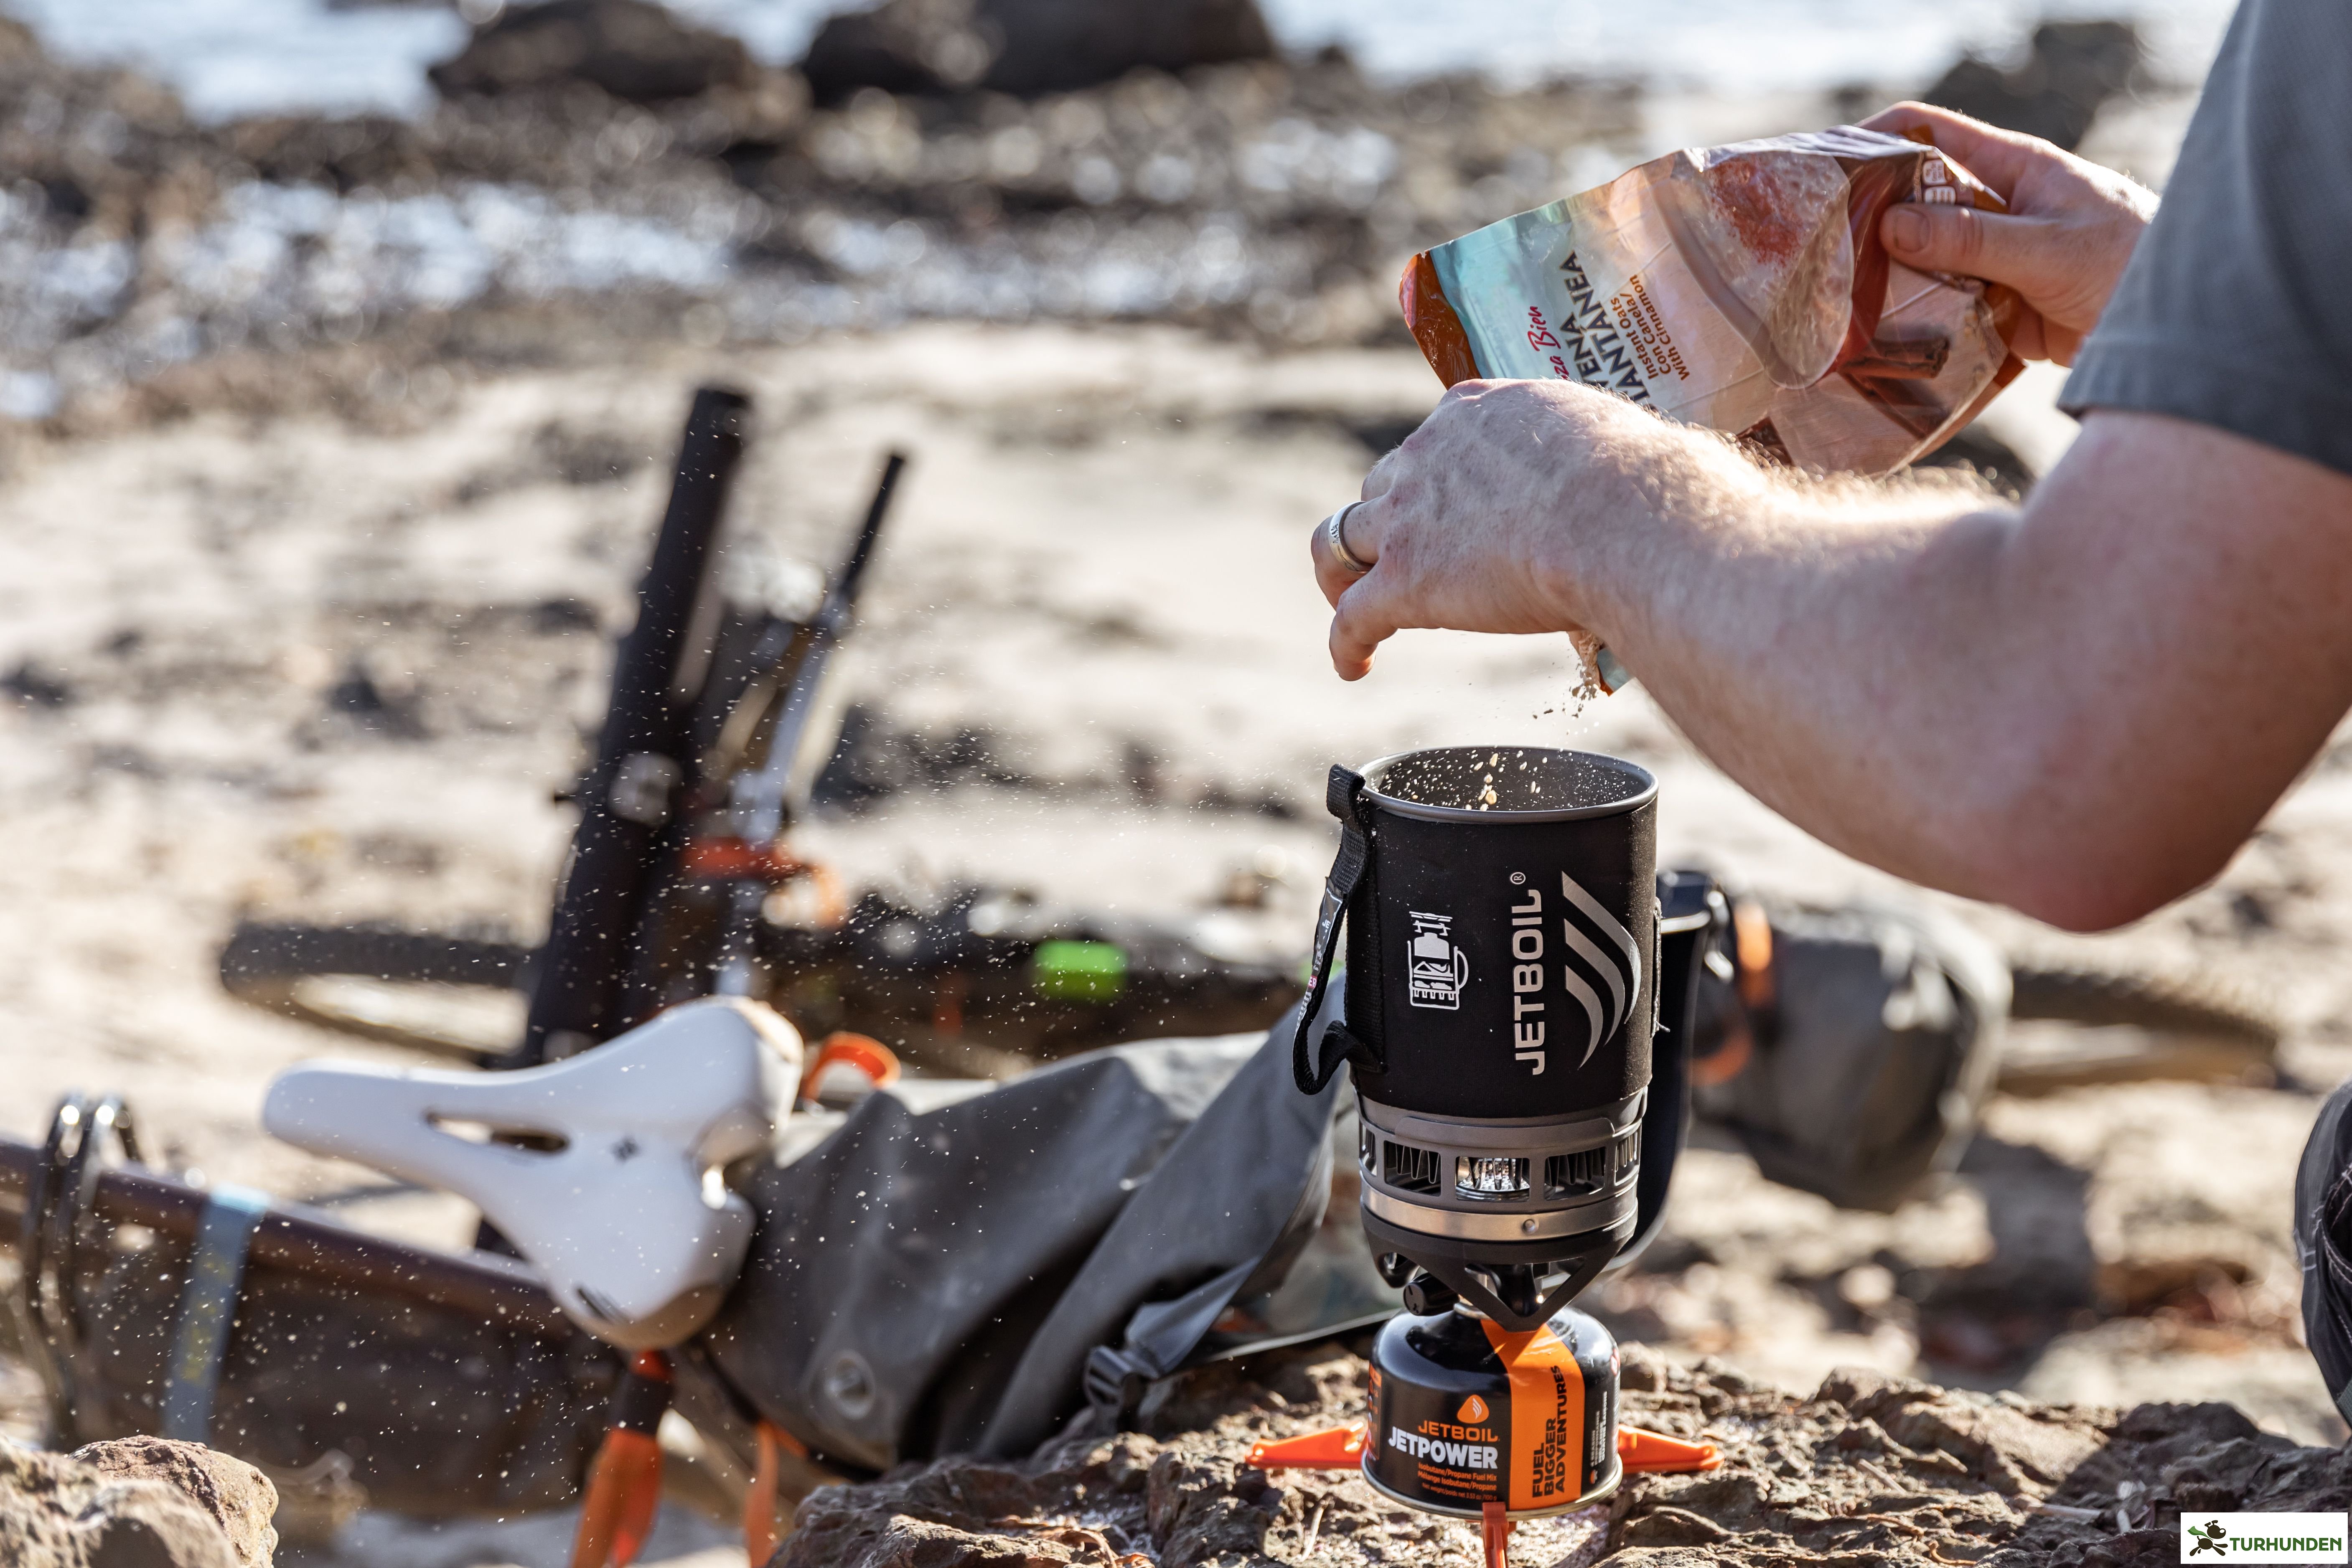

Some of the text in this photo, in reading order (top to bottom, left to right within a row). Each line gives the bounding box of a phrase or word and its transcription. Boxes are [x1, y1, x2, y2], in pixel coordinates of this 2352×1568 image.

[1528, 306, 1561, 352] Bien
[1611, 297, 1659, 379] Instant Oats
[1620, 292, 1672, 375] Con Canela/
[1388, 1426, 1498, 1469] JETPOWER
[1418, 1420, 1499, 1442] JETBOIL
[1551, 1365, 1567, 1493] ADVENTURES
[1418, 1462, 1471, 1479] Isobutane/Propane
[1473, 1473, 1486, 1481] Fuel
[1532, 1443, 1544, 1498] FUEL
[1544, 1417, 1556, 1496] BIGGER
[1442, 1477, 1497, 1492] Isobutane/Propane
